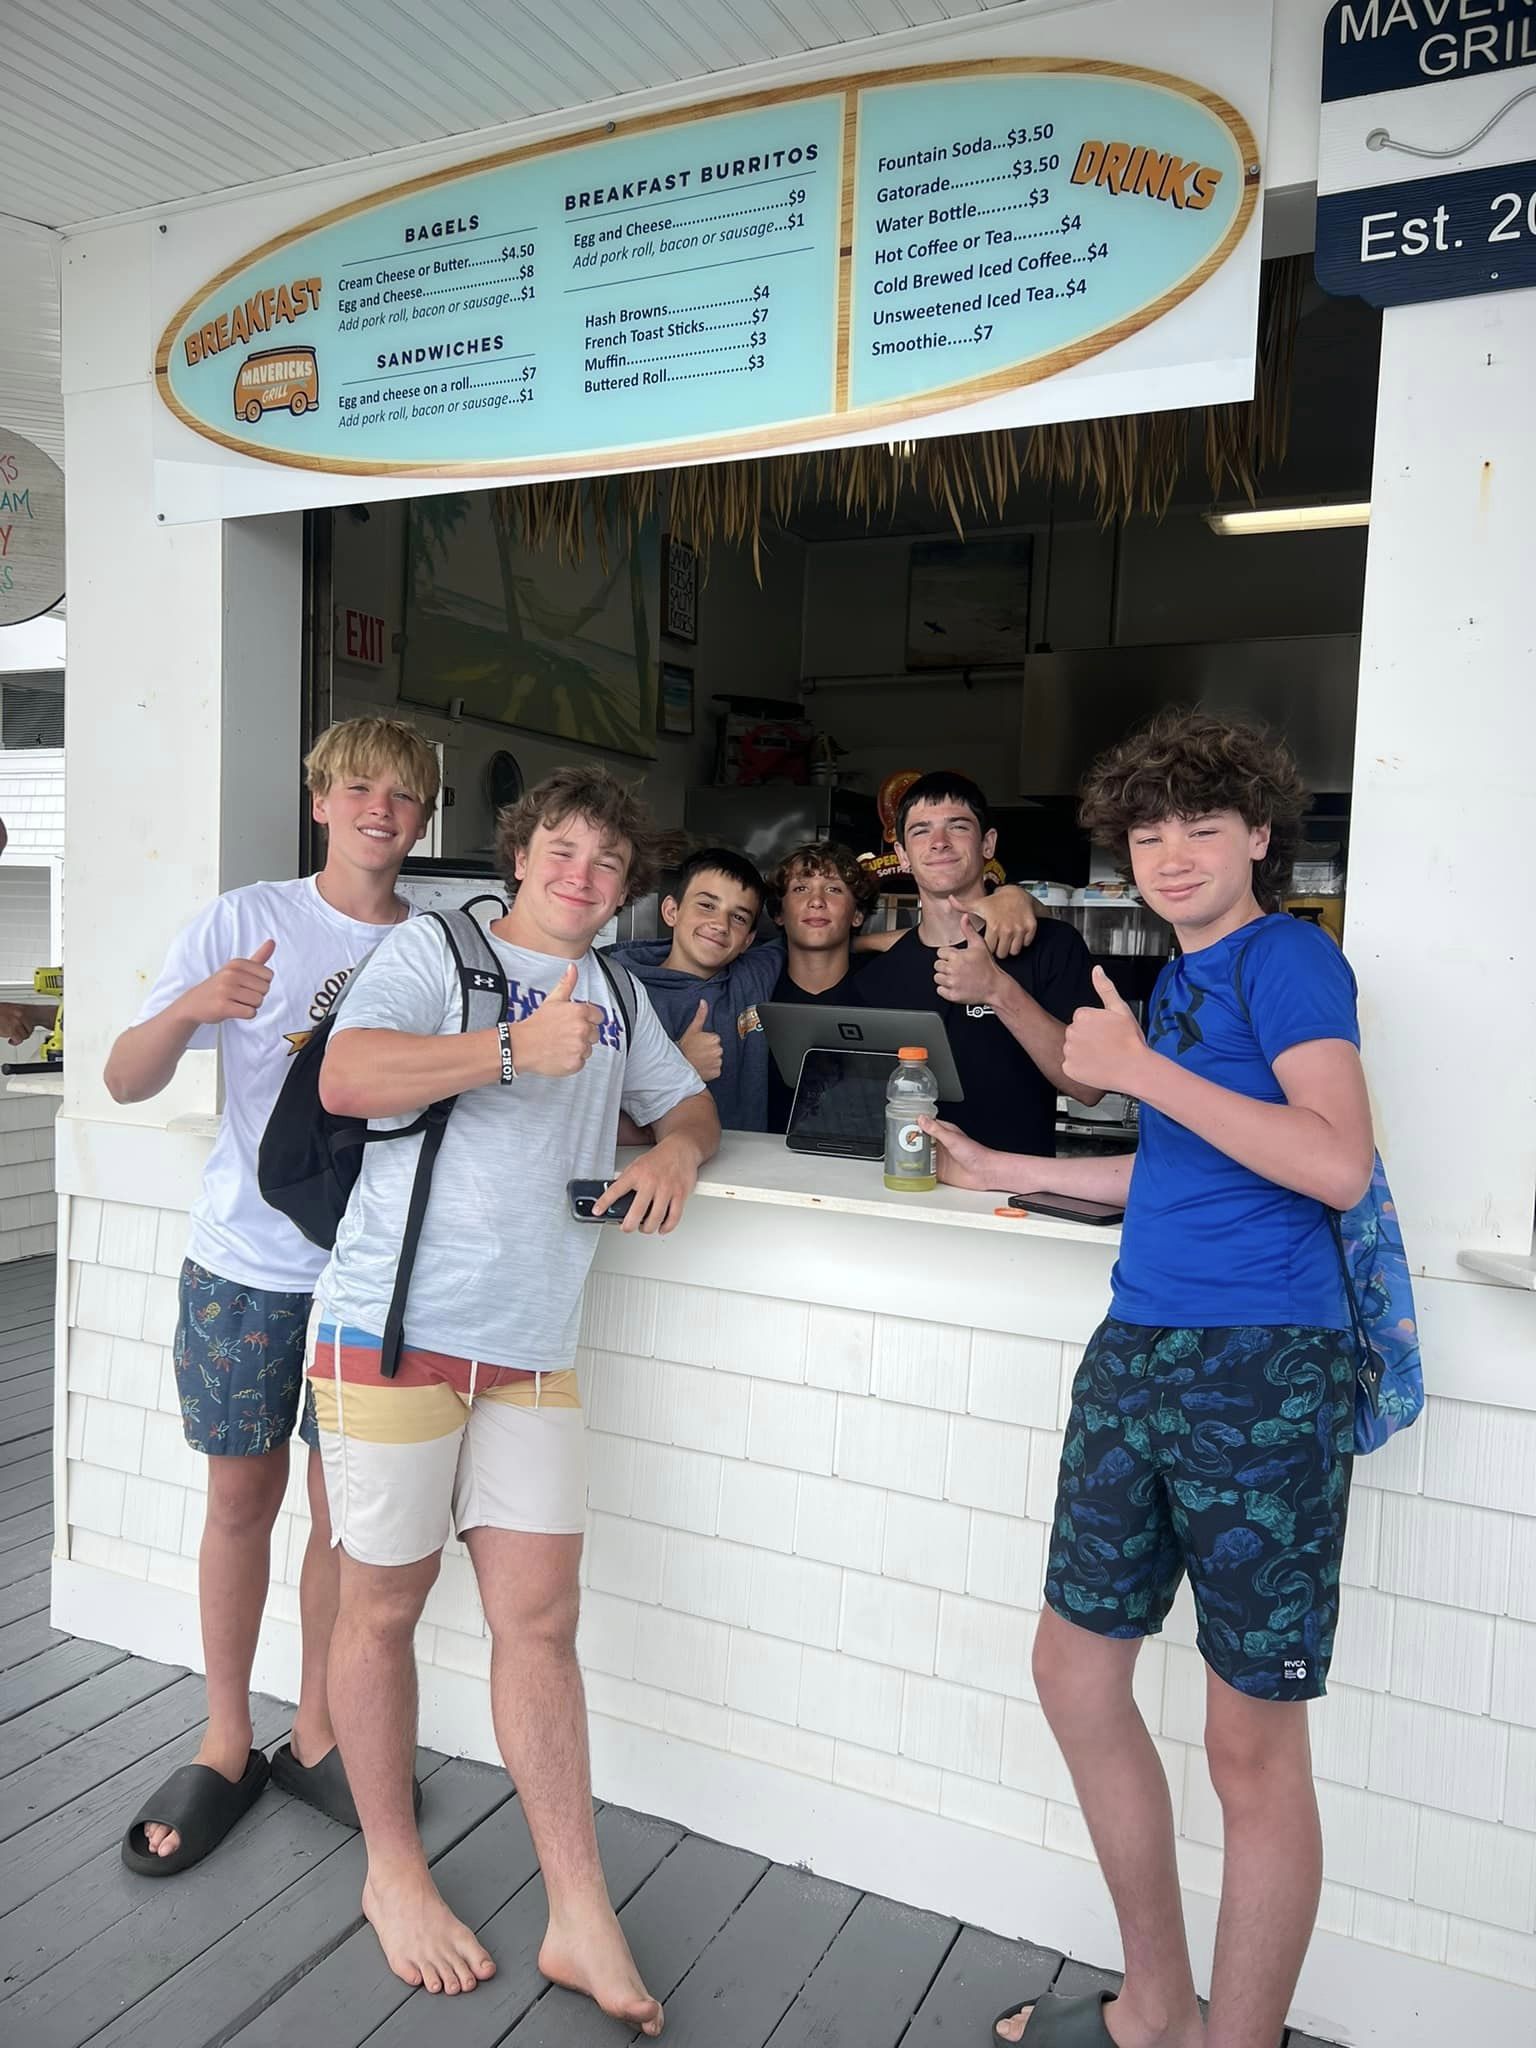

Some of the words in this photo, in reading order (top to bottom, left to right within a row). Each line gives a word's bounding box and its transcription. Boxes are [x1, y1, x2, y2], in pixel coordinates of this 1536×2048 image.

[1339, 0, 1536, 45] MAVE
[878, 147, 948, 173] Fountain
[952, 137, 993, 158] Soda
[1007, 123, 1054, 148] $3.50
[565, 170, 691, 211] BREAKFAST
[700, 143, 819, 183] BURRITOS
[877, 176, 951, 203] Gatorade
[1012, 154, 1060, 179] $3.50
[1070, 140, 1224, 210] DRINKS
[404, 214, 480, 243] BAGELS
[574, 233, 596, 249] Egg
[599, 226, 623, 243] and
[625, 217, 673, 238] Cheese
[788, 189, 806, 207] $9
[876, 214, 924, 234] Water
[928, 202, 977, 224] Bottle
[1029, 188, 1050, 208] $3
[1360, 205, 1463, 263] Est.
[573, 251, 597, 269] Add
[600, 244, 629, 266] pork
[631, 240, 656, 258] roll,
[659, 235, 698, 254] bacon
[702, 231, 717, 245] or
[719, 220, 775, 242] sausage
[787, 213, 805, 231] $1
[875, 248, 904, 266] Hot
[907, 237, 959, 260] Coffee
[962, 234, 981, 250] or
[985, 227, 1013, 245] Tea
[1060, 215, 1082, 234] $4
[338, 274, 373, 293] Cream
[375, 267, 416, 287] Cheese
[417, 265, 431, 279] or
[432, 257, 469, 275] Butter
[501, 243, 535, 264] $4.50
[338, 297, 358, 316] Egg
[359, 291, 381, 308] and
[383, 285, 422, 305] Cheese
[519, 264, 535, 281] $8
[874, 276, 908, 296] Cold
[913, 264, 975, 290] Brewed
[979, 257, 1013, 277] Iced
[1017, 248, 1073, 273] Coffee
[1087, 242, 1109, 263] $4
[183, 277, 323, 367] BREAKFAST
[338, 314, 359, 332] Add
[361, 309, 386, 330] pork
[388, 306, 408, 325] roll,
[411, 302, 445, 319] bacon
[447, 301, 461, 314] or
[463, 291, 510, 311] sausage
[520, 286, 535, 303] $1
[585, 312, 616, 328] Hash
[619, 304, 669, 323] Browns
[753, 285, 770, 301] $4
[873, 294, 983, 325] Unsweetened
[987, 287, 1022, 308] Iced
[1026, 284, 1055, 302] Tea
[1065, 278, 1088, 298] $4
[376, 335, 505, 369] SANDWICHES
[585, 331, 627, 350] French
[630, 327, 664, 344] Toast
[667, 319, 706, 337] Sticks
[752, 308, 769, 325] $7
[585, 354, 627, 371] Muffin
[750, 331, 767, 348] $3
[872, 332, 948, 357] Smoothie
[973, 325, 994, 344] $7
[241, 360, 313, 386] MAVERICKS
[262, 384, 288, 403] GRILL
[339, 393, 358, 411] Egg
[359, 389, 381, 407] and
[382, 384, 421, 402] cheese
[423, 383, 438, 398] on
[440, 381, 448, 394] a
[450, 376, 470, 392] roll
[522, 366, 537, 383] $7
[584, 375, 639, 393] Buttered
[642, 368, 667, 386] Roll
[748, 355, 765, 371] $3
[338, 411, 359, 429] Add
[361, 406, 386, 427] pork
[388, 403, 408, 422] roll,
[411, 399, 444, 416] bacon
[447, 399, 460, 412] or
[463, 391, 509, 411] sausage
[519, 388, 534, 405] $1
[346, 609, 385, 664] EXIT
[309, 968, 354, 1022] COOP
[502, 1048, 512, 1080] CHOP
